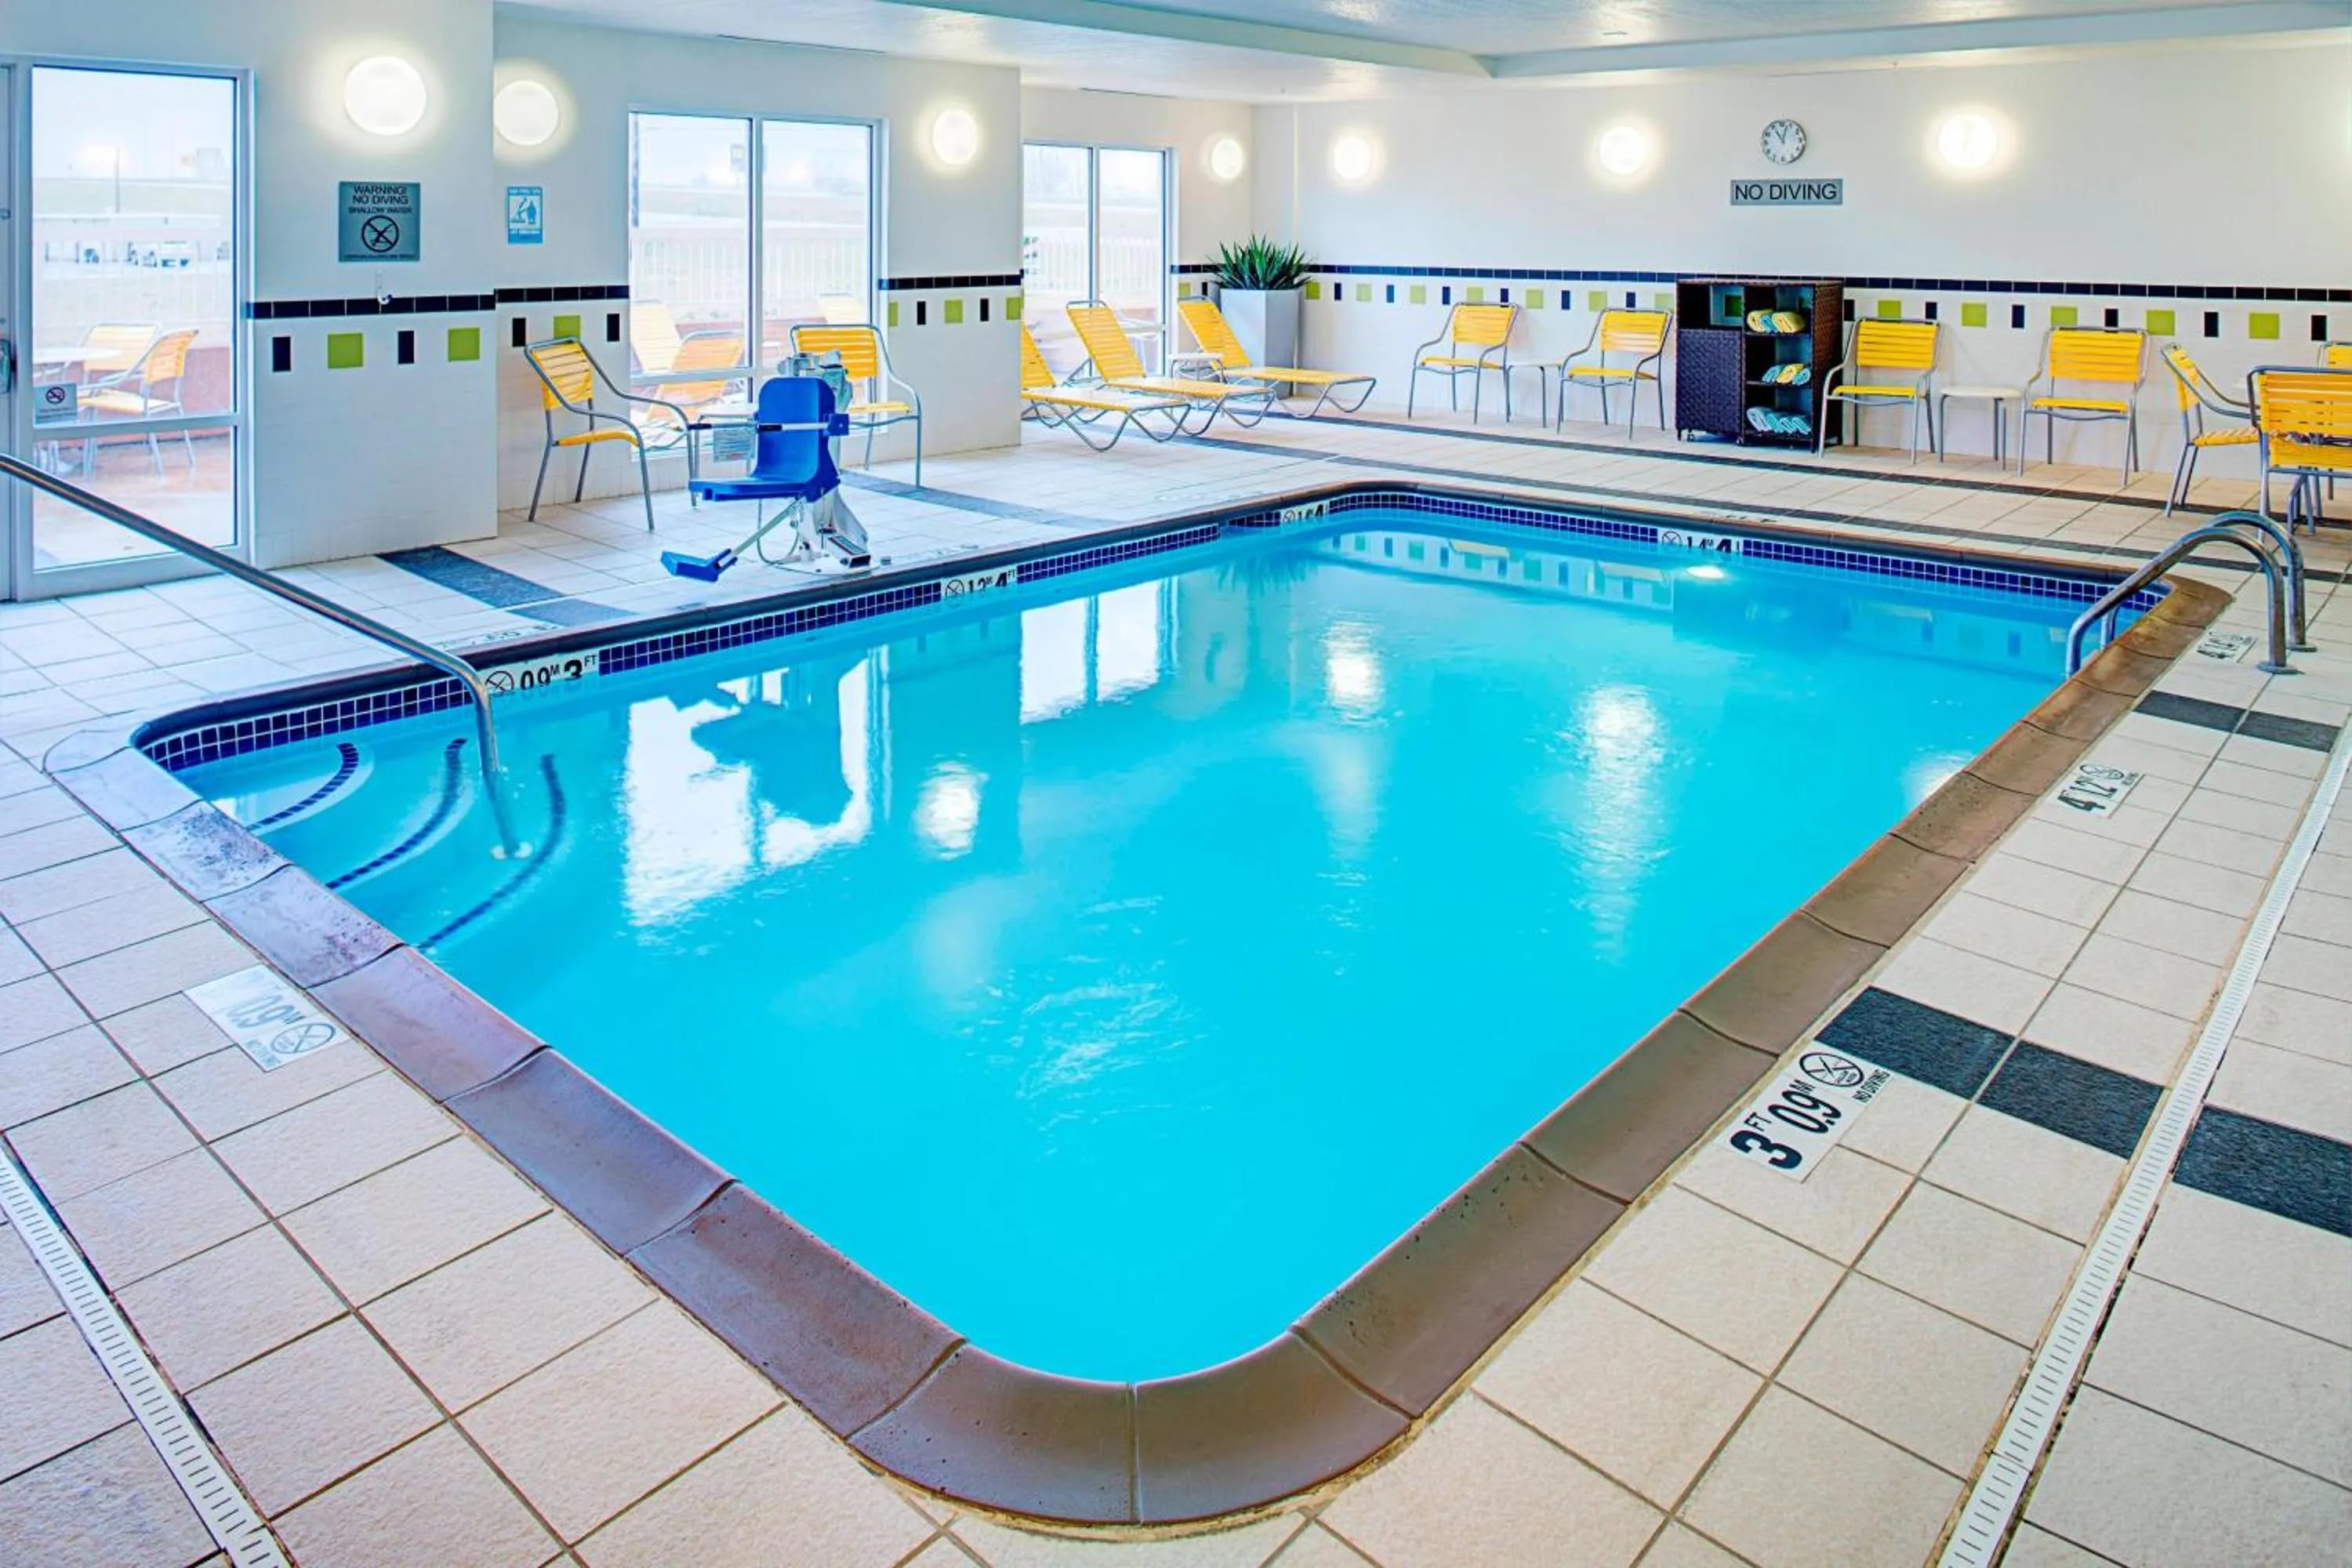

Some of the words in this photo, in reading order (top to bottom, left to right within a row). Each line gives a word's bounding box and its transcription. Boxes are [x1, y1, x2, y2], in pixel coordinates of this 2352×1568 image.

[1735, 183, 1763, 200] NO
[1769, 183, 1837, 200] DIVING
[352, 195, 368, 204] NO
[372, 195, 408, 204] DIVING
